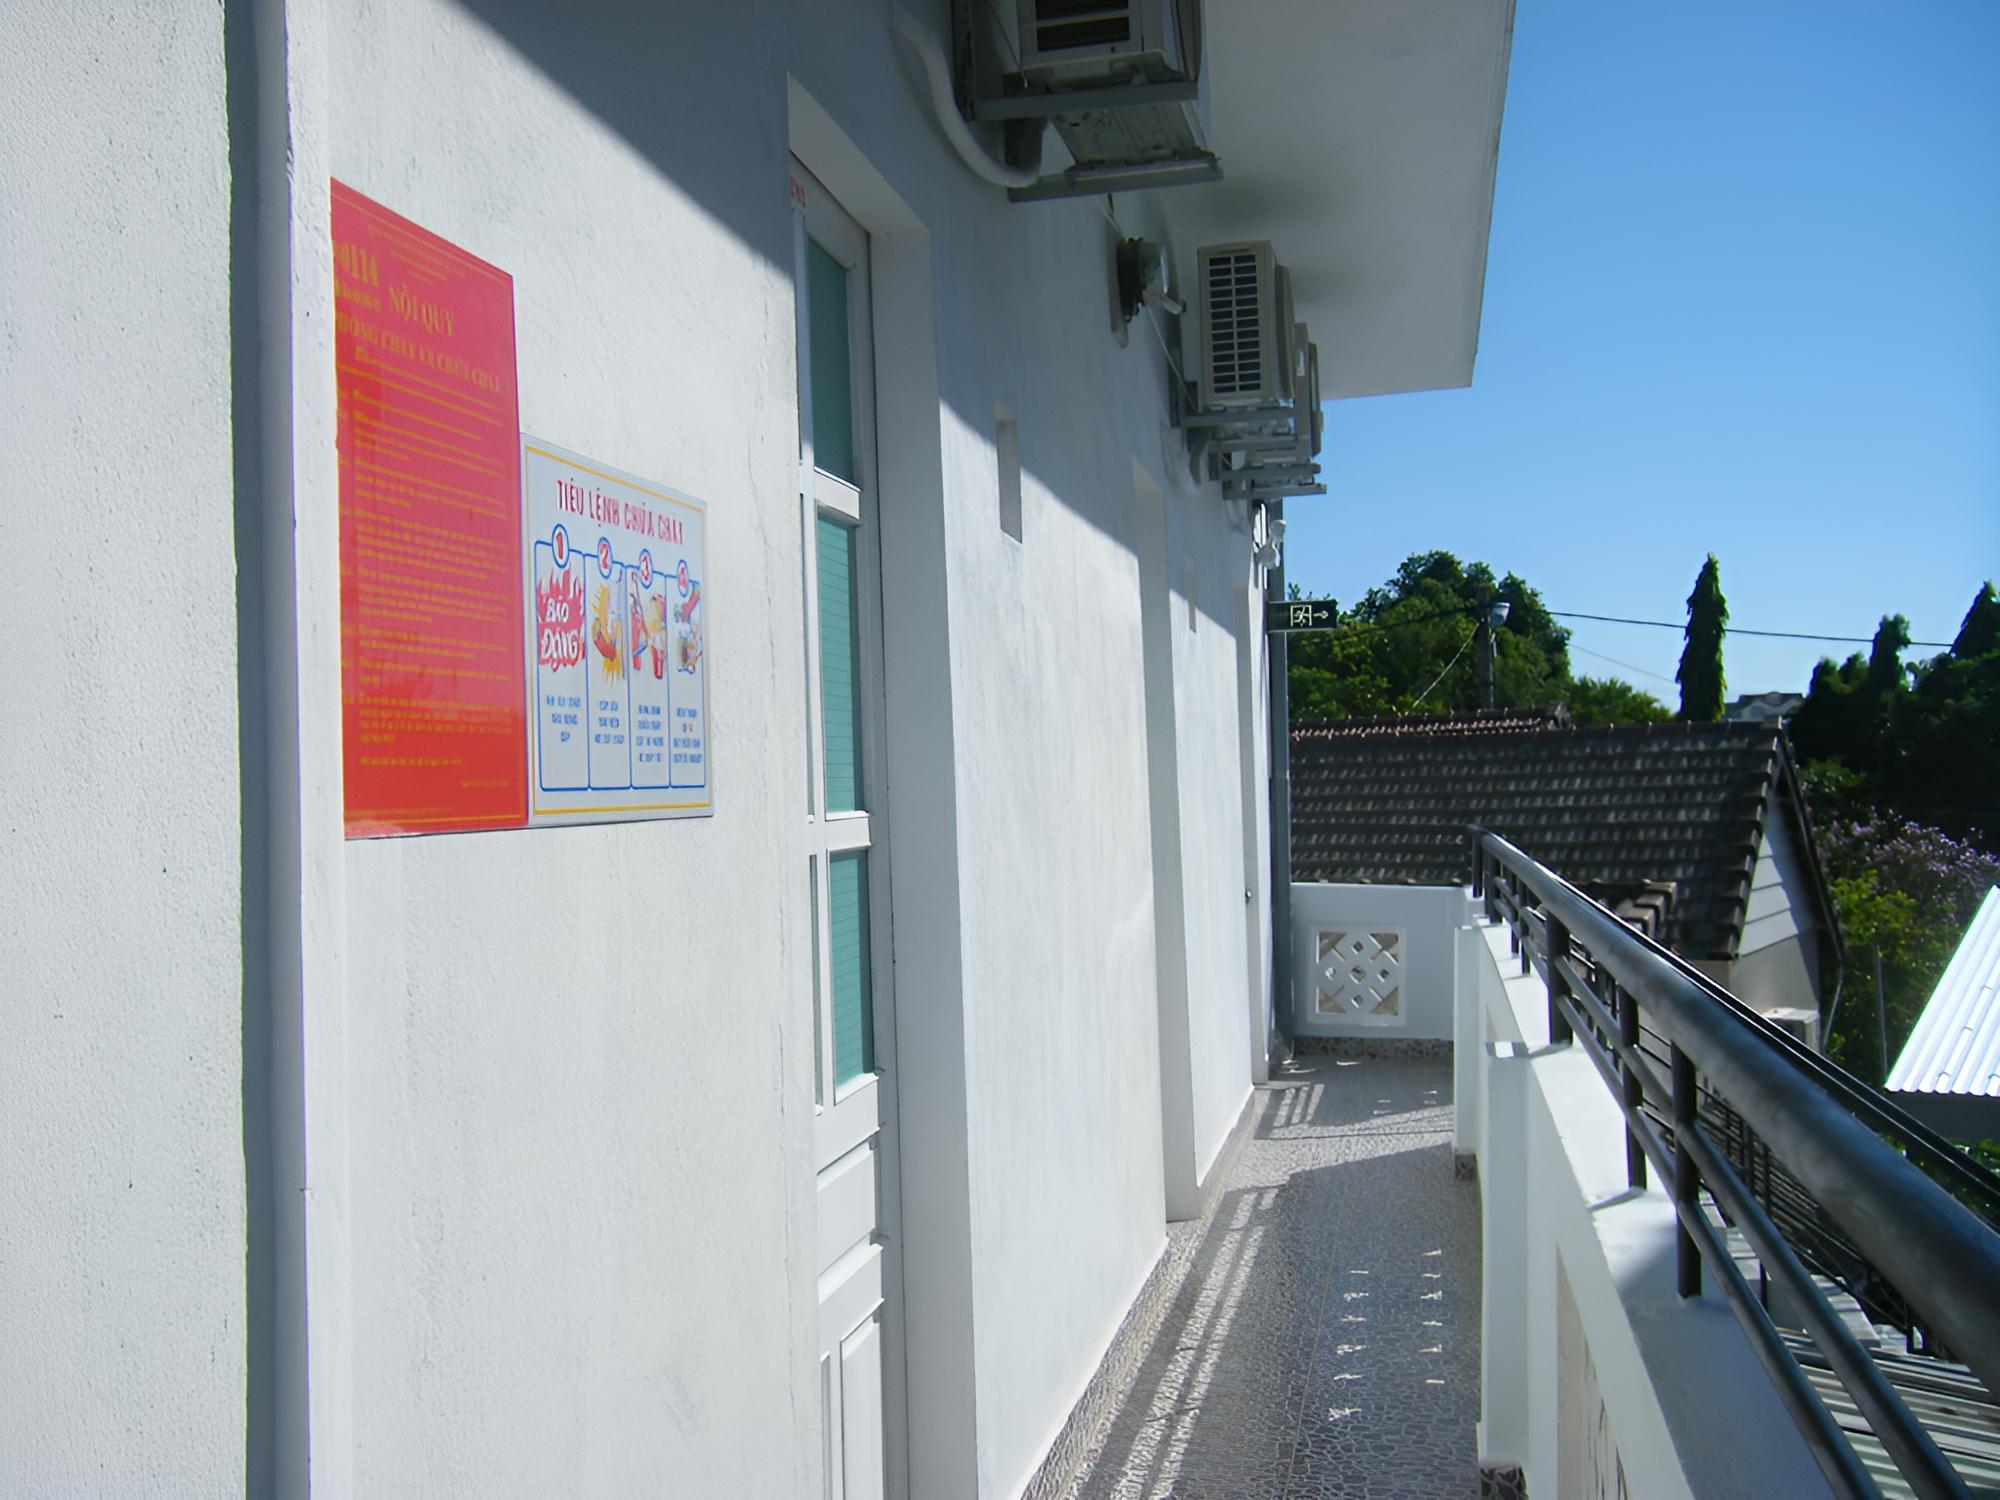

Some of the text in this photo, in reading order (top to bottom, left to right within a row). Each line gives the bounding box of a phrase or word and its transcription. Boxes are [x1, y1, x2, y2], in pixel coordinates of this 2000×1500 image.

[556, 531, 564, 561] 1
[600, 543, 609, 570] 2
[641, 556, 650, 582] 3
